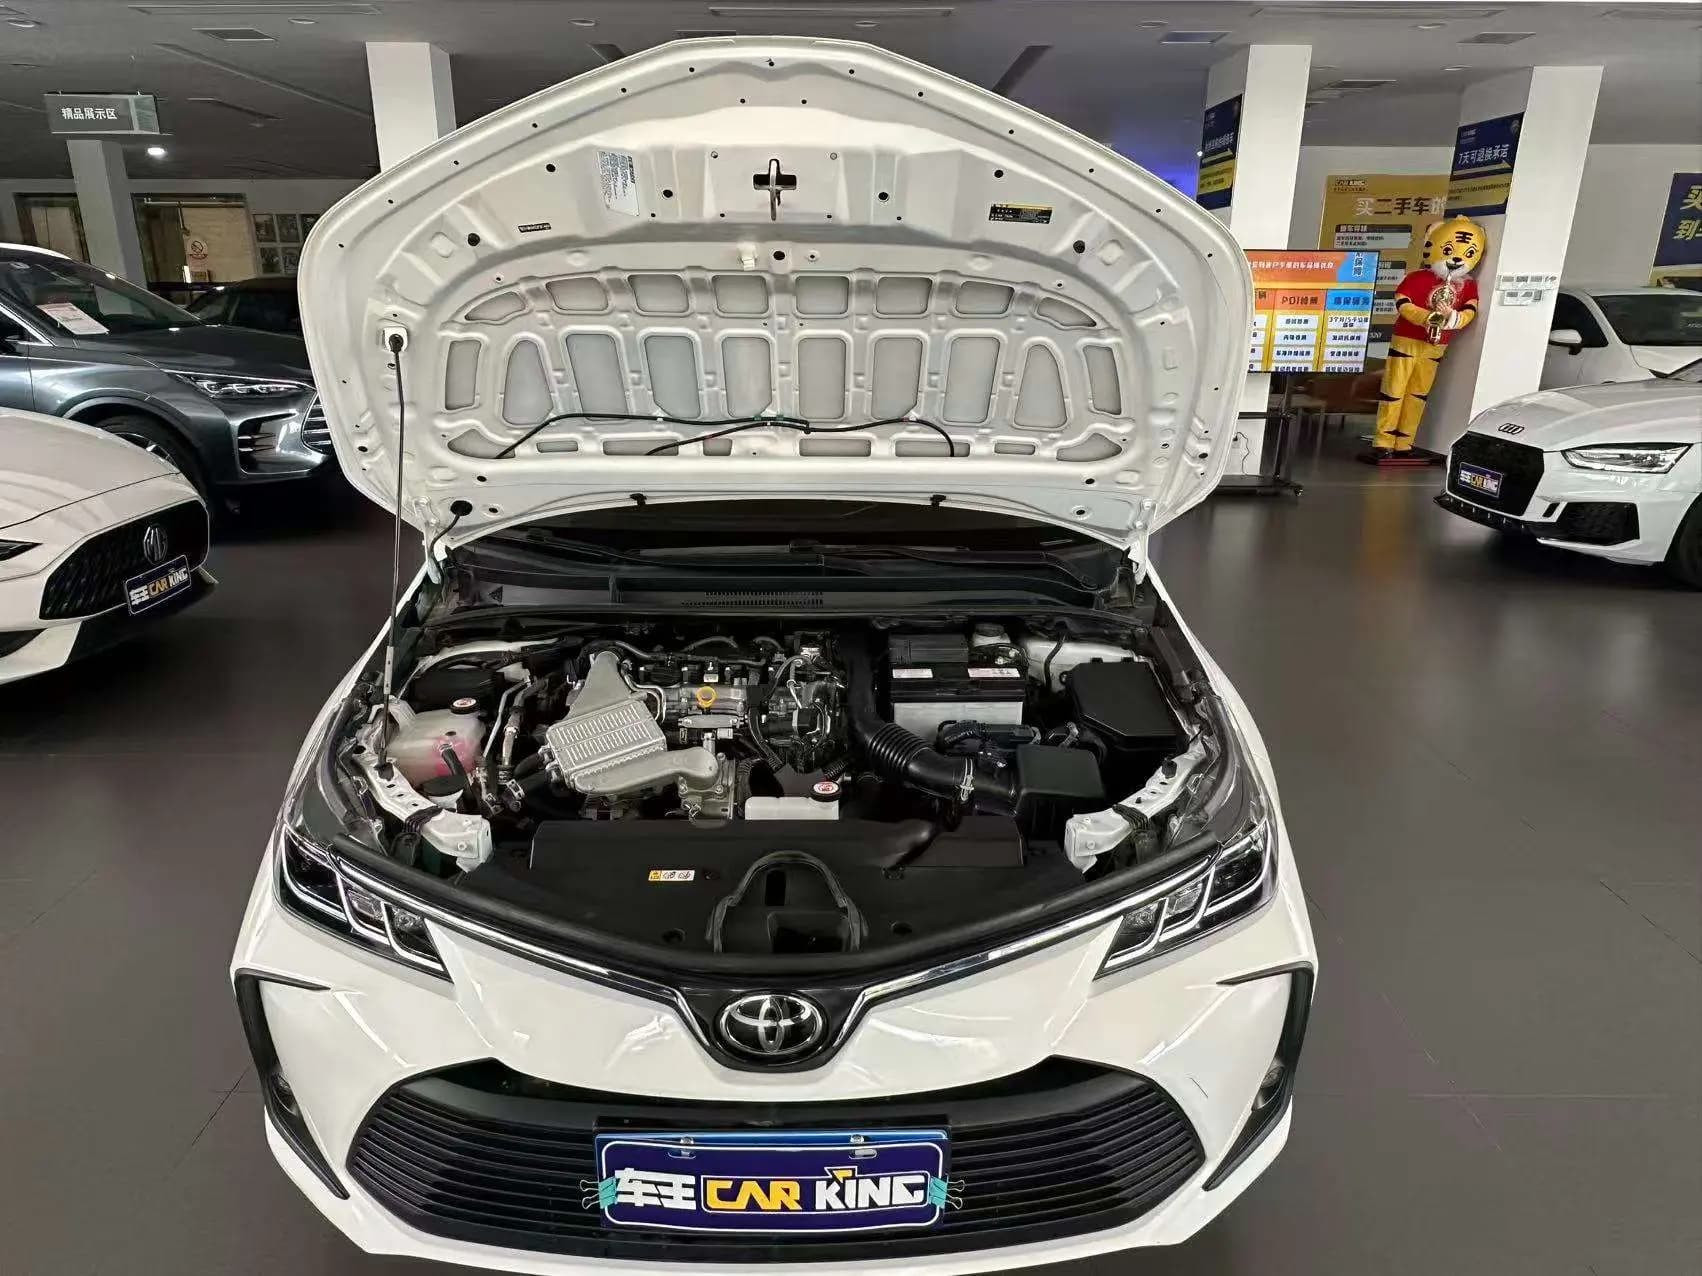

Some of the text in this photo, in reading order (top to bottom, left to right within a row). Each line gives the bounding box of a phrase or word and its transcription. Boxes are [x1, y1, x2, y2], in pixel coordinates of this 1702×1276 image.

[61, 107, 118, 120] 精品展示区
[149, 579, 169, 596] CAR
[168, 567, 188, 587] KING
[615, 1167, 926, 1211] 车王 CAR KING
